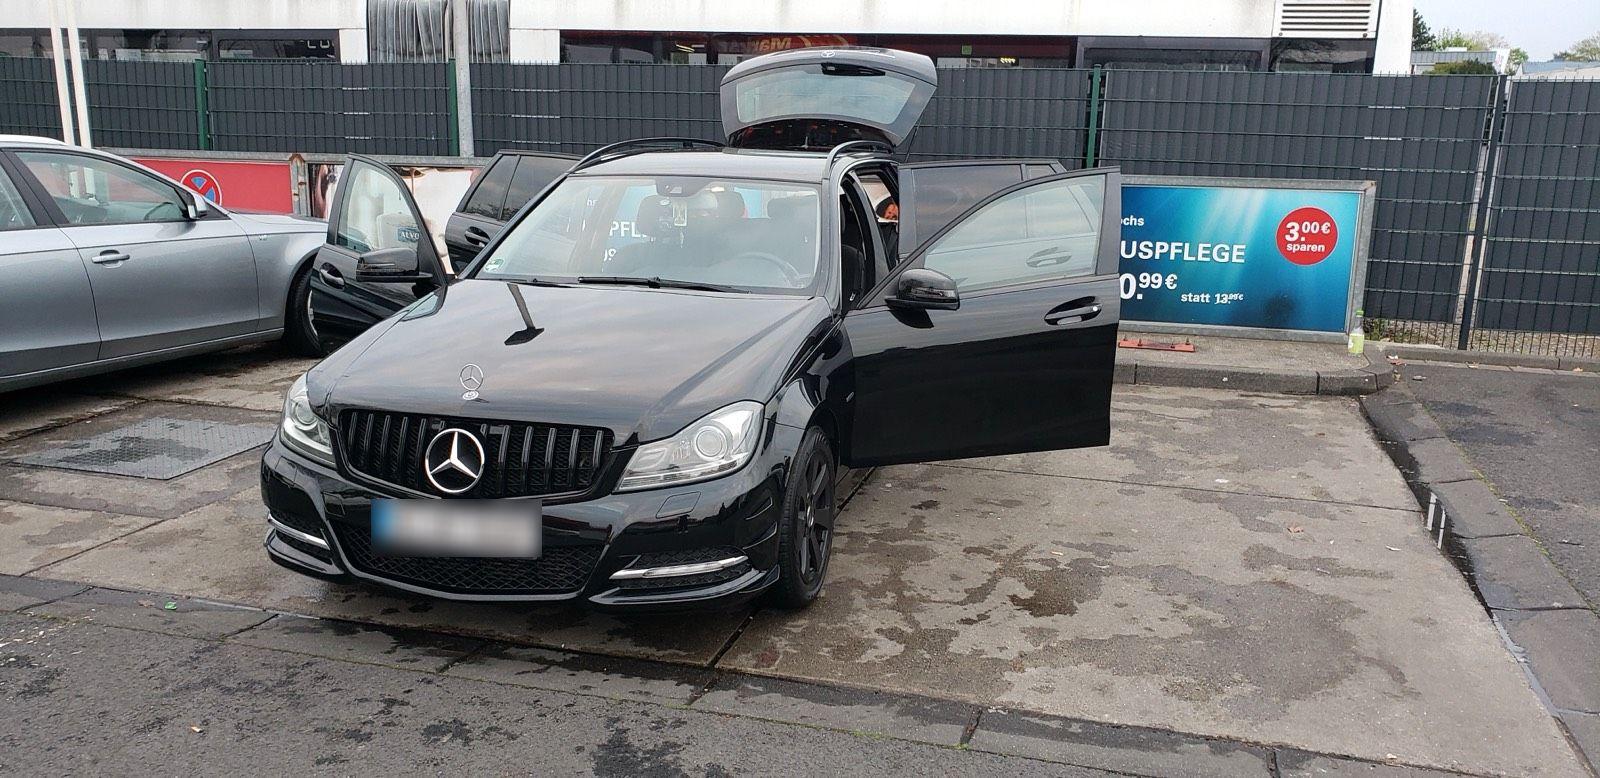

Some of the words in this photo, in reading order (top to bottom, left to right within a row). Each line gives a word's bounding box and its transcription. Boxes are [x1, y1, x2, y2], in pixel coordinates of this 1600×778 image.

[1120, 240, 1246, 263] USPFLEGE
[1286, 243, 1326, 253] sparen
[1181, 292, 1211, 303] statt
